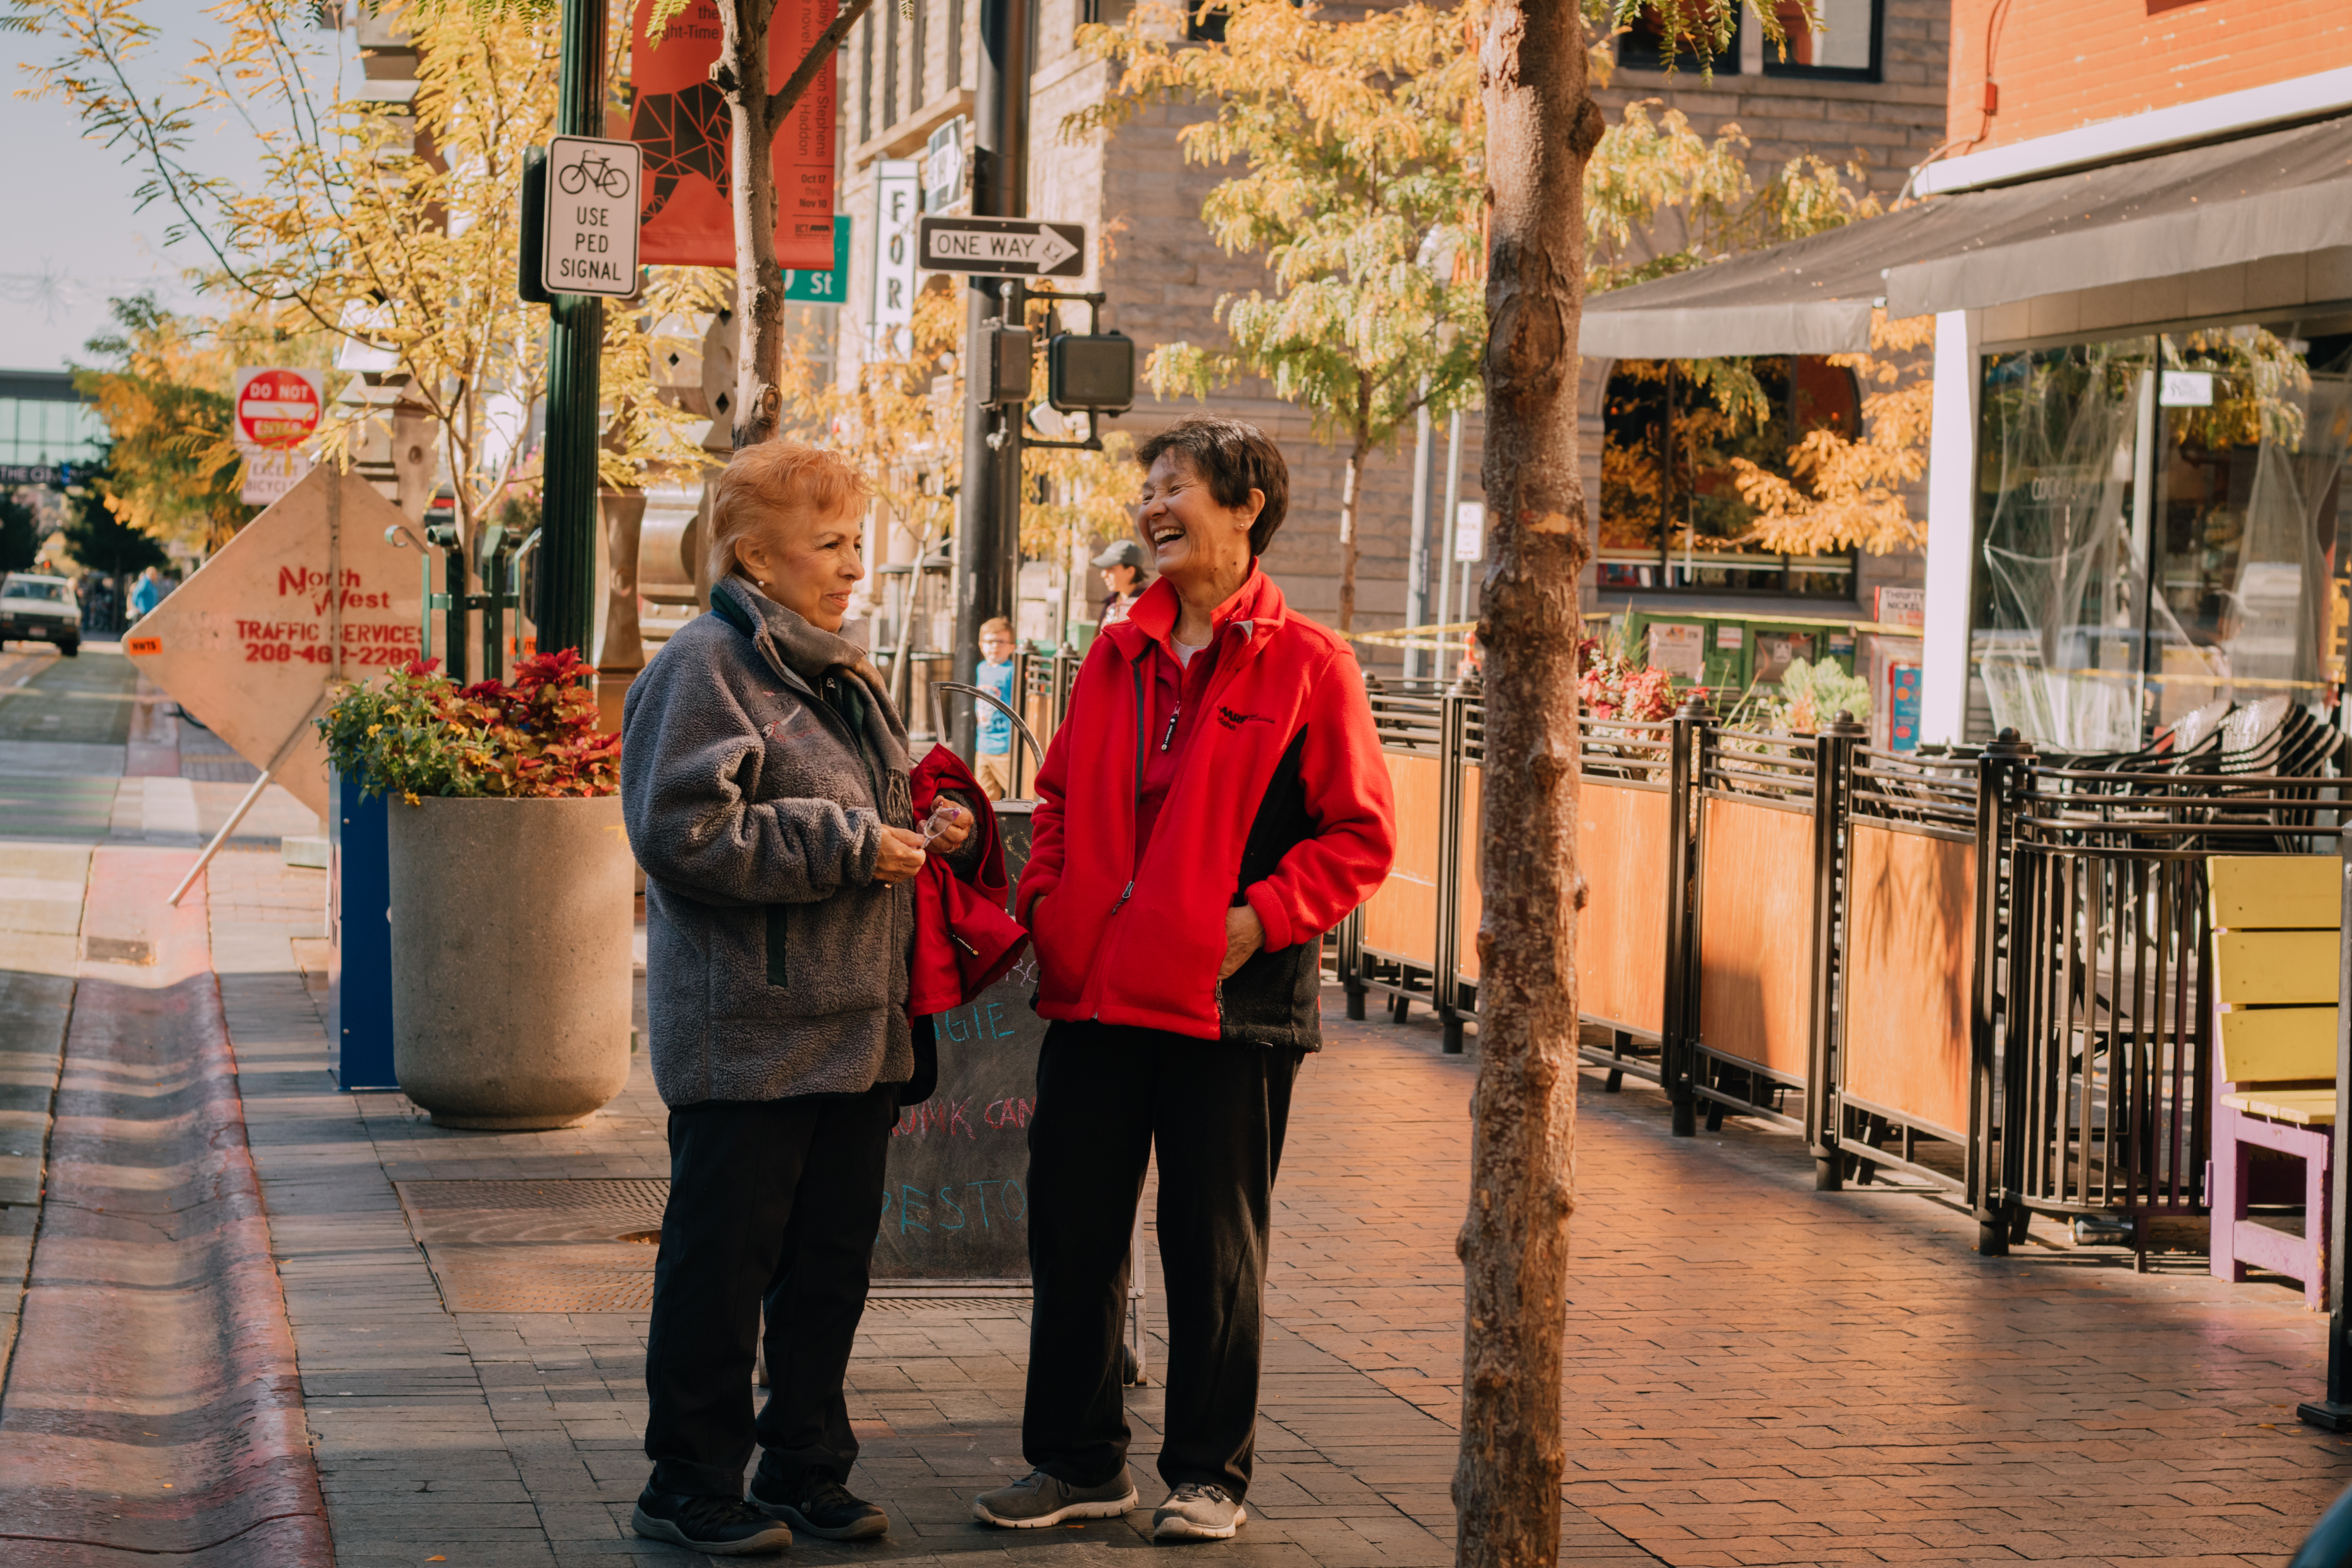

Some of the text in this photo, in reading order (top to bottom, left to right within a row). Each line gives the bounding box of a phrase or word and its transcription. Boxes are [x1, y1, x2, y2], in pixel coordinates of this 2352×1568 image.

[698, 5, 719, 19] the
[652, 24, 719, 41] ght-Time
[801, 8, 813, 43] novel
[799, 104, 811, 156] Haddon
[815, 96, 830, 158] Stephens
[801, 174, 827, 184] Oct 17
[799, 198, 827, 208] Nov 10
[577, 206, 609, 227] USE
[575, 233, 608, 253] PED
[938, 234, 1035, 257] ONE WAY
[560, 258, 622, 281] SIGNAL
[810, 272, 833, 295] St
[250, 383, 308, 401] DO NOT
[253, 462, 300, 476] EXCET
[236, 619, 319, 641] TRAFFIC
[934, 1002, 1015, 1042] GIE
[891, 1096, 977, 1140] UNK
